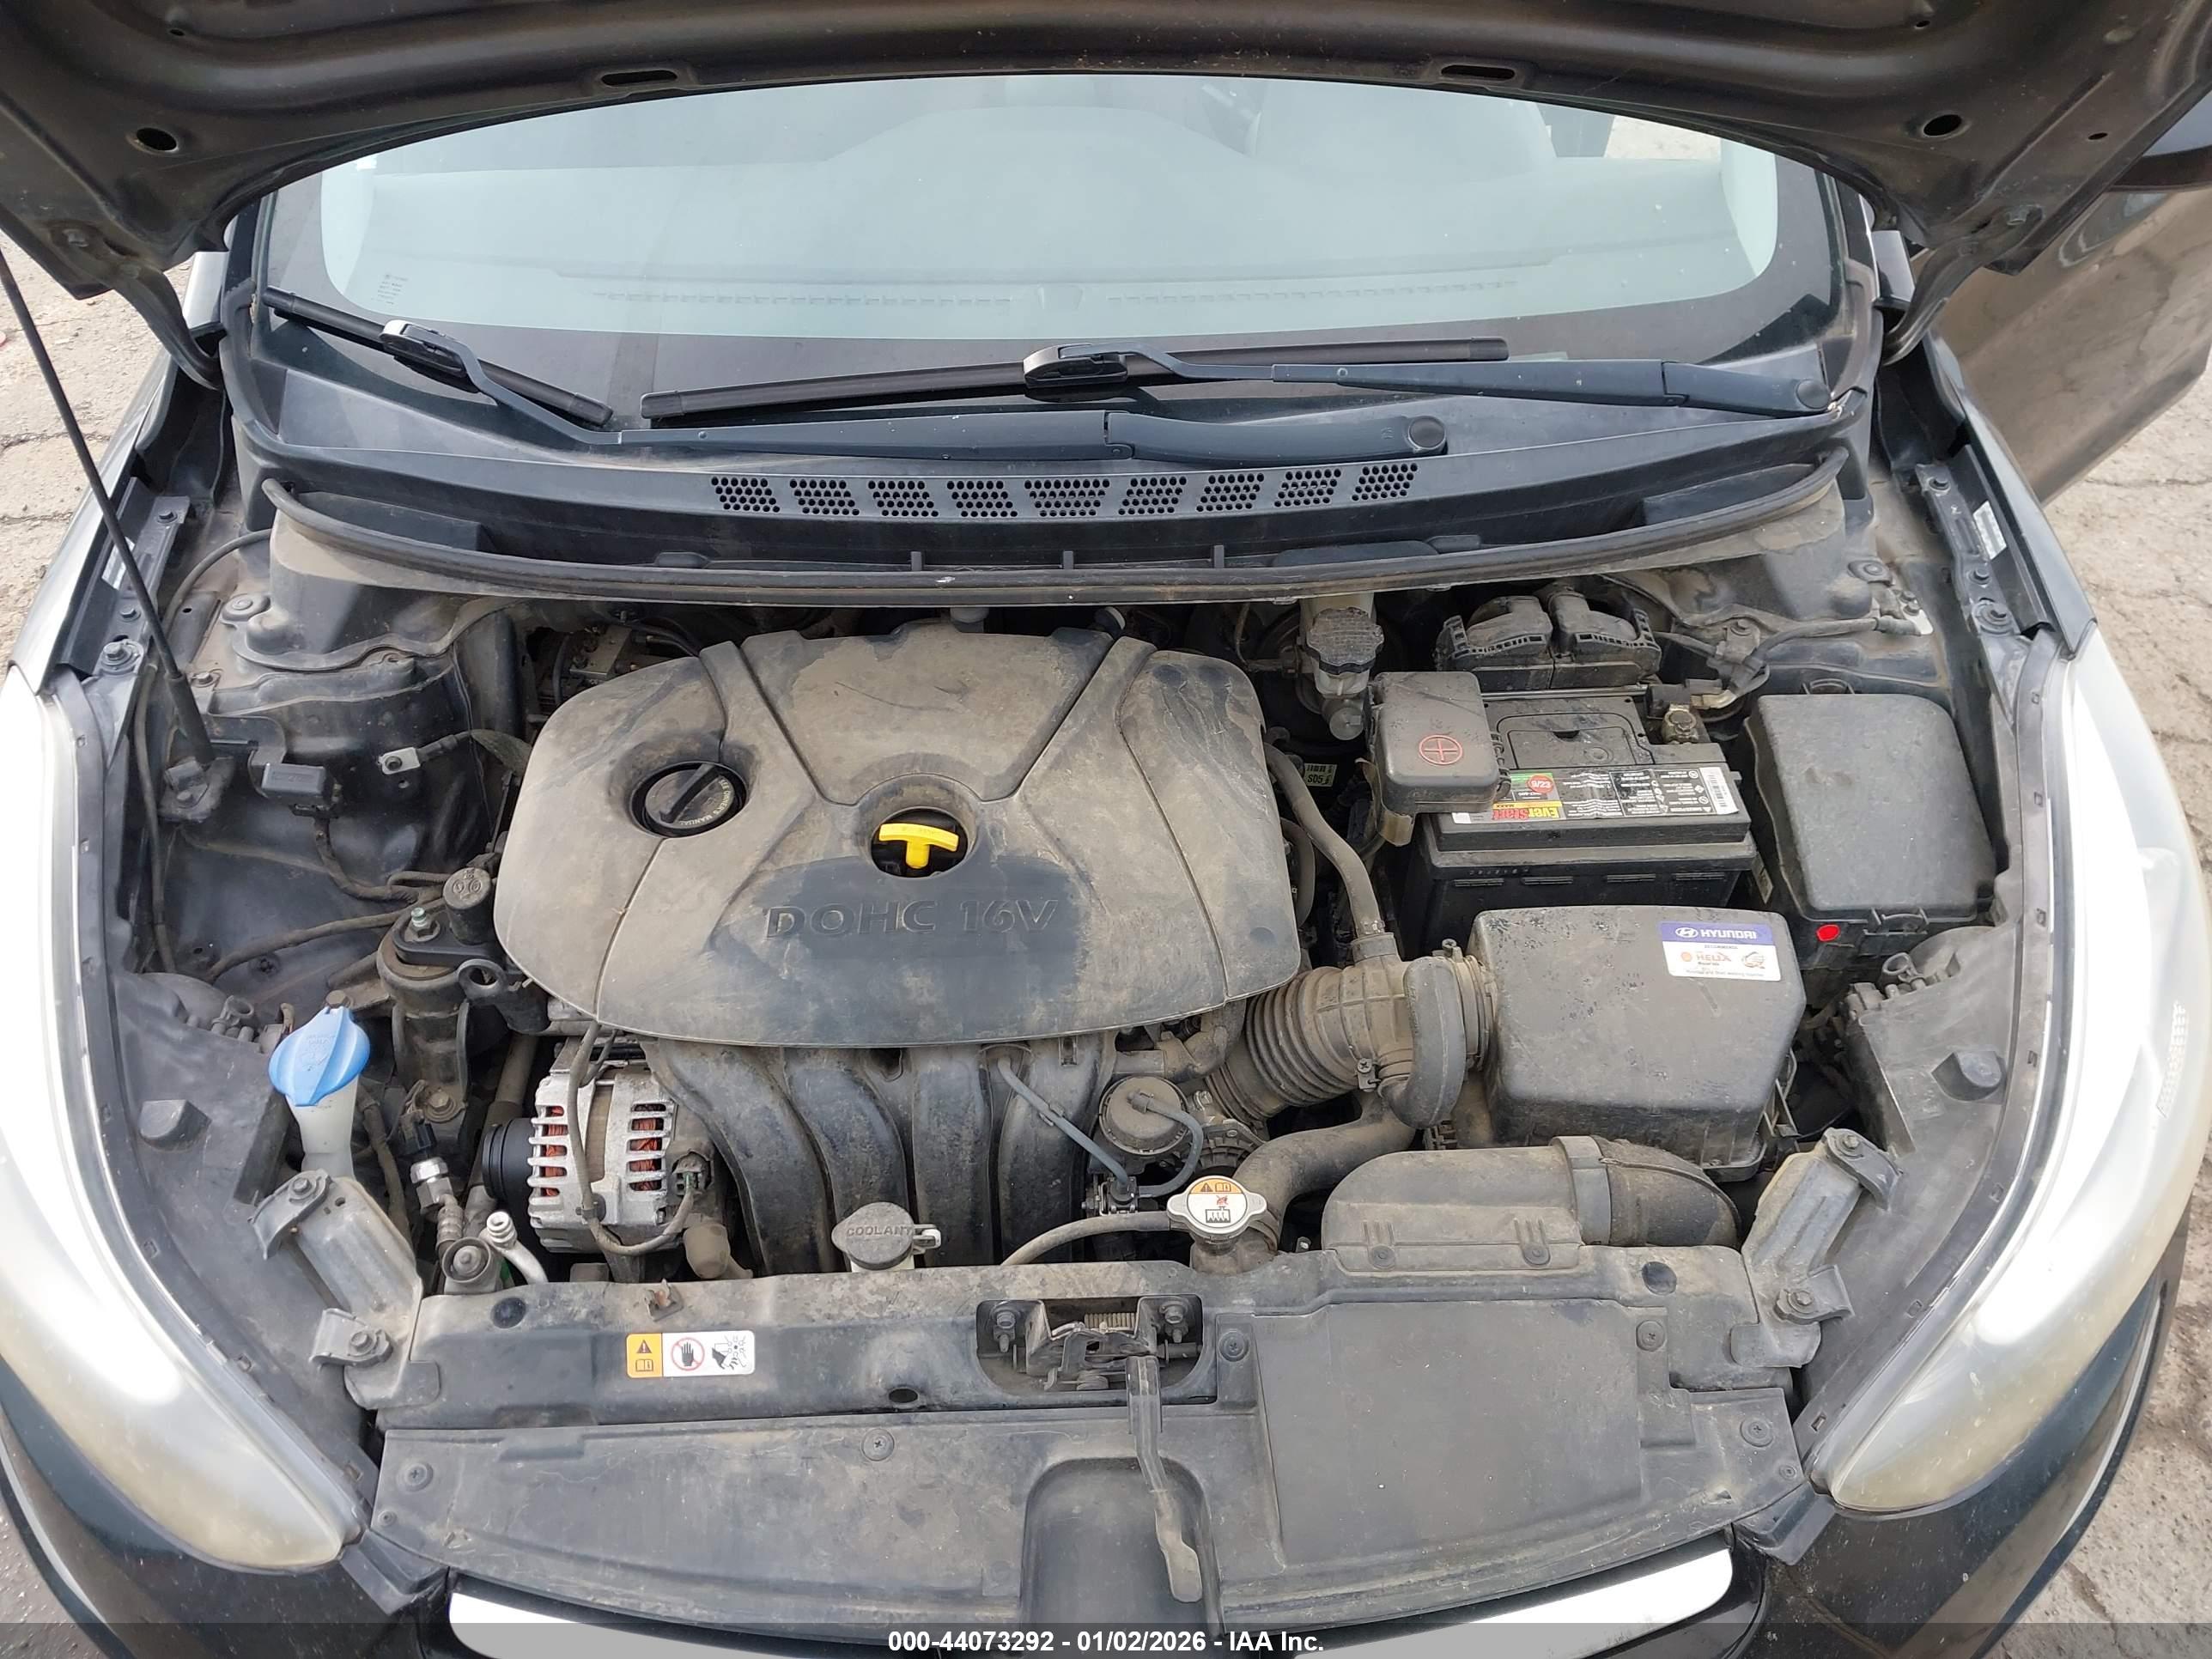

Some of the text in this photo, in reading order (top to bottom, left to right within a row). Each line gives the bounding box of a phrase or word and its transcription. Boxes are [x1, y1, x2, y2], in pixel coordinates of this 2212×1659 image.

[1492, 807, 1559, 820] EverStart
[764, 899, 1059, 939] DOHC 16V
[1700, 929, 1758, 939] HYUNDAI
[846, 1225, 913, 1237] COOLANT
